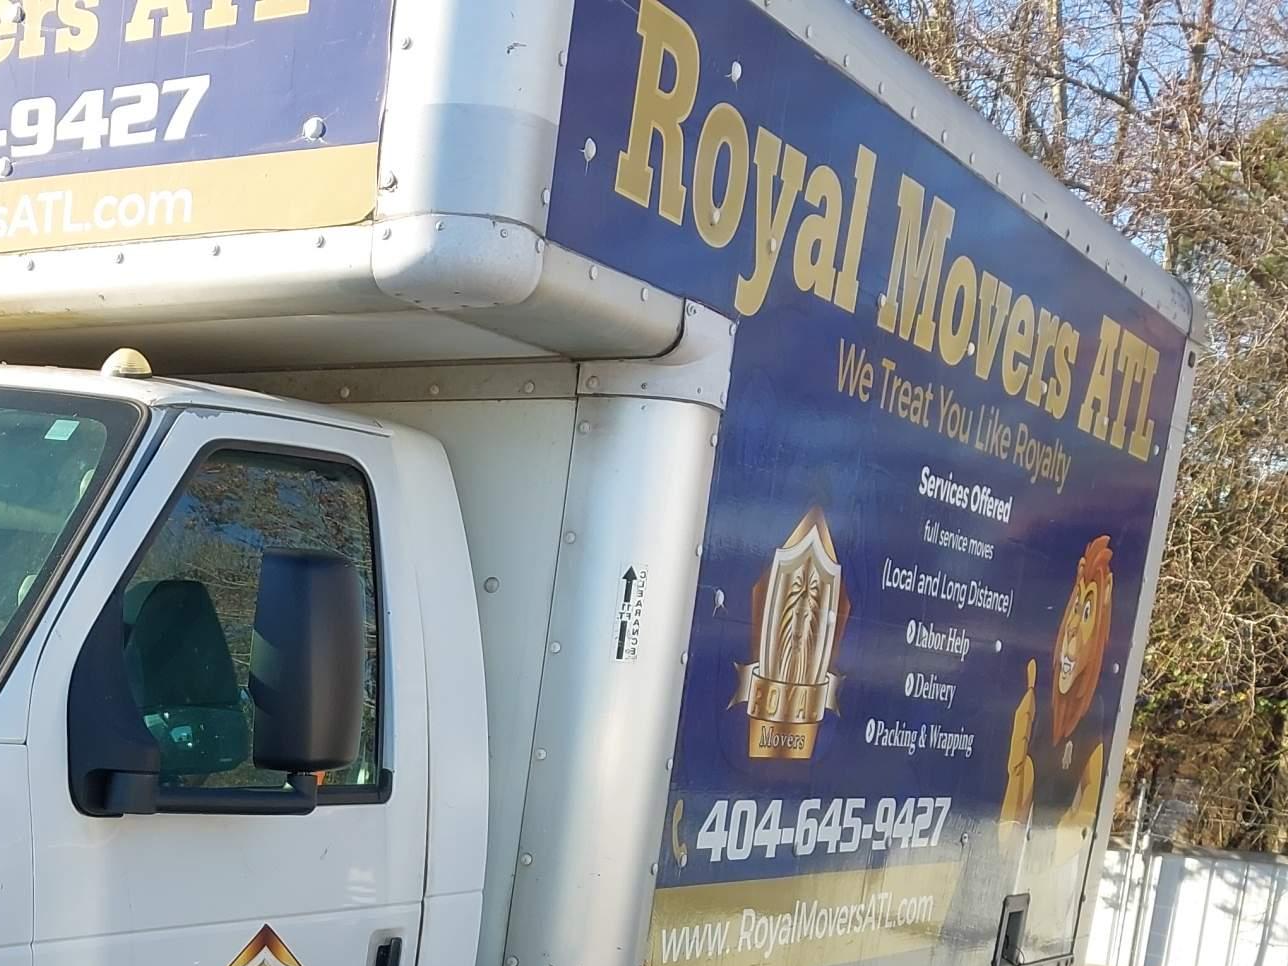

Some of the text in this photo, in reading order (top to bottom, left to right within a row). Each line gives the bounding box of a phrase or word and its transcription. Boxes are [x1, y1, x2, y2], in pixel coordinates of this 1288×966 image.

[615, 0, 1161, 462] Royal Movers ATL
[838, 338, 1071, 494] We Treat You Like Royalty
[919, 466, 1013, 523] Services Offered
[923, 519, 994, 560] full service moves
[882, 557, 1013, 617] (Local and Long Distance)
[916, 621, 970, 662] Labor Help
[914, 673, 956, 709] Delivery
[759, 725, 806, 750] Movers
[874, 720, 975, 758] Packing & Wrapping
[696, 797, 952, 863] 404-645-9427
[661, 892, 934, 965] www. RoyalMoversATL.com
